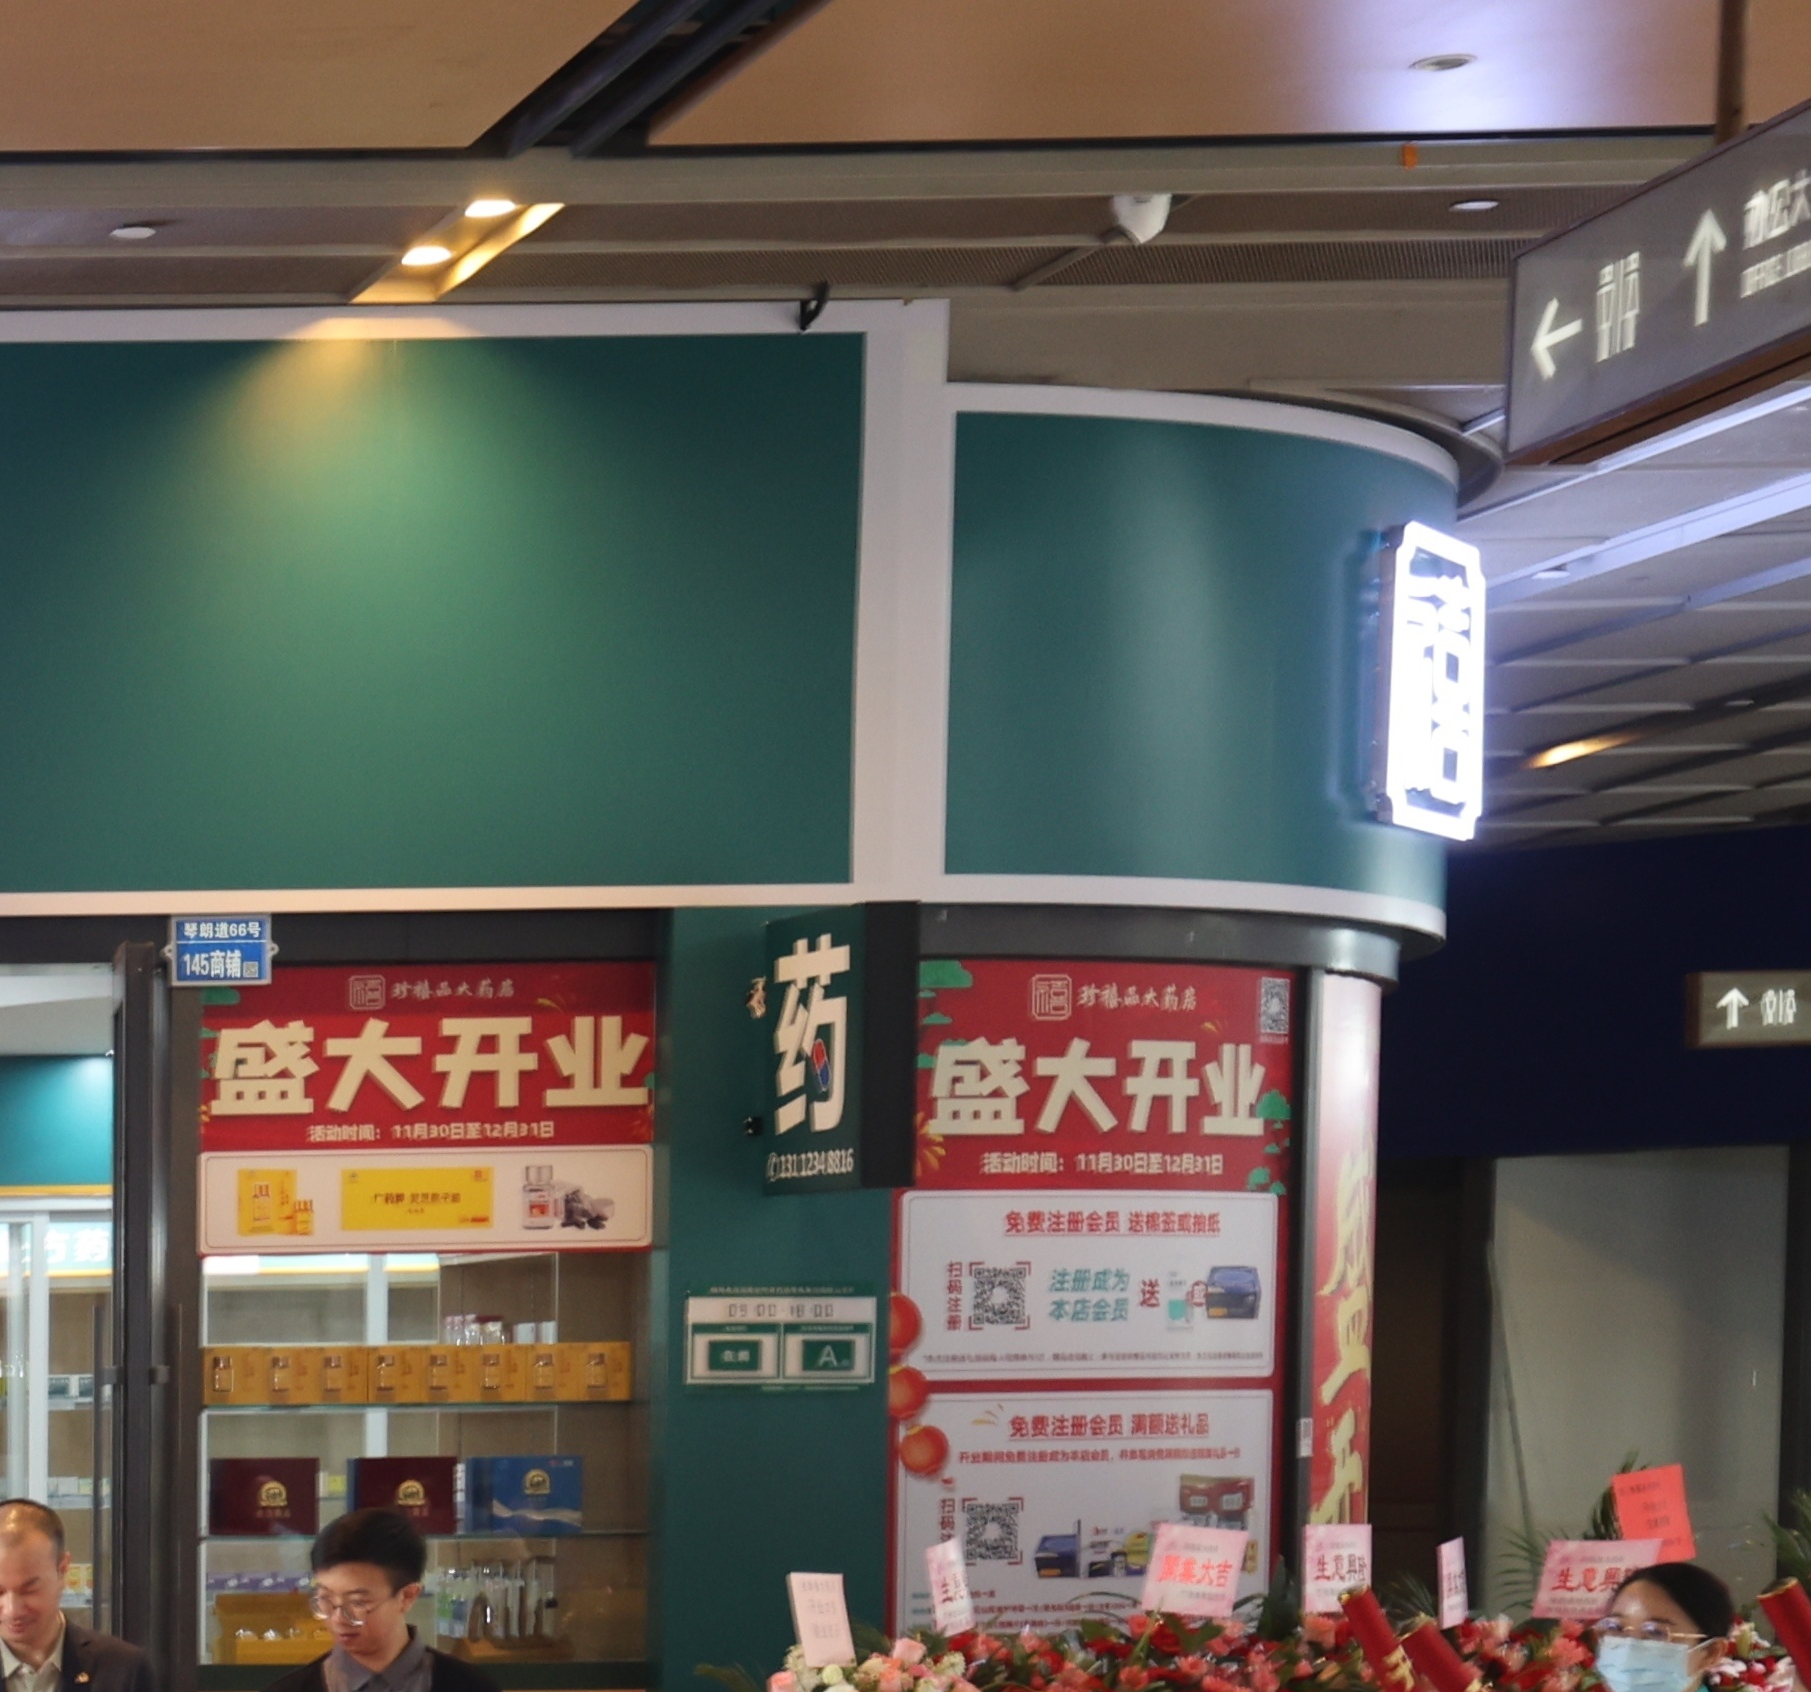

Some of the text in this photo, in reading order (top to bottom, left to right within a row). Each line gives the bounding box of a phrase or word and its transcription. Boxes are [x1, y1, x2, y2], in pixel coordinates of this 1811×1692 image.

[183, 921, 262, 939] 琴朗道66号
[183, 949, 242, 978] 145商铺
[389, 977, 516, 999] 珍禧品大药房
[1077, 983, 1198, 1011] 珍禧品大药房
[773, 932, 852, 1135] 药
[209, 1014, 650, 1116] 盛大开业
[928, 1036, 1266, 1136] 盛大开业
[1004, 1209, 1222, 1234] 免费注册会员 送棉签或抽纸
[1047, 1266, 1132, 1293] 注册成为
[1048, 1297, 1131, 1323] 本店会员
[1008, 1412, 1211, 1438] 免费注册会员 满额送礼品
